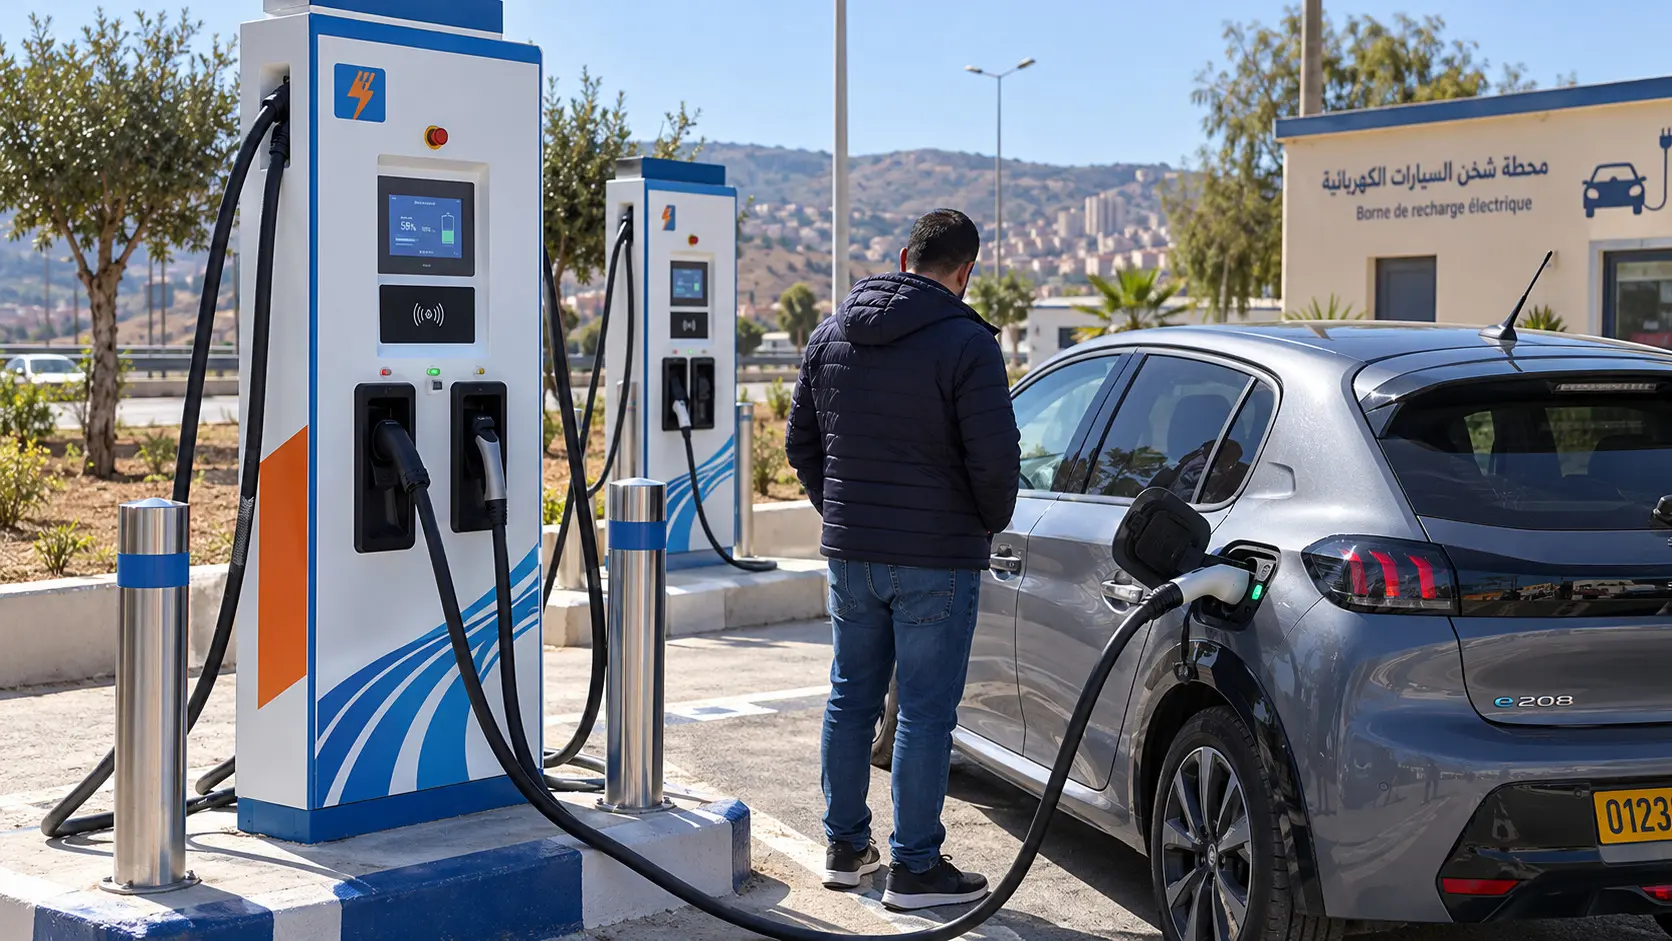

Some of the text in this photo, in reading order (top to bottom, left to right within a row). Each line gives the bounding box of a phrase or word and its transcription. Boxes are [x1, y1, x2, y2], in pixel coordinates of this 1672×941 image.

[1322, 166, 1387, 196] الكهربائية
[1391, 160, 1453, 191] السيارات
[1502, 155, 1549, 177] محطة
[1356, 196, 1533, 221] Borne de recharge électrique
[1606, 796, 1672, 835] 0123
